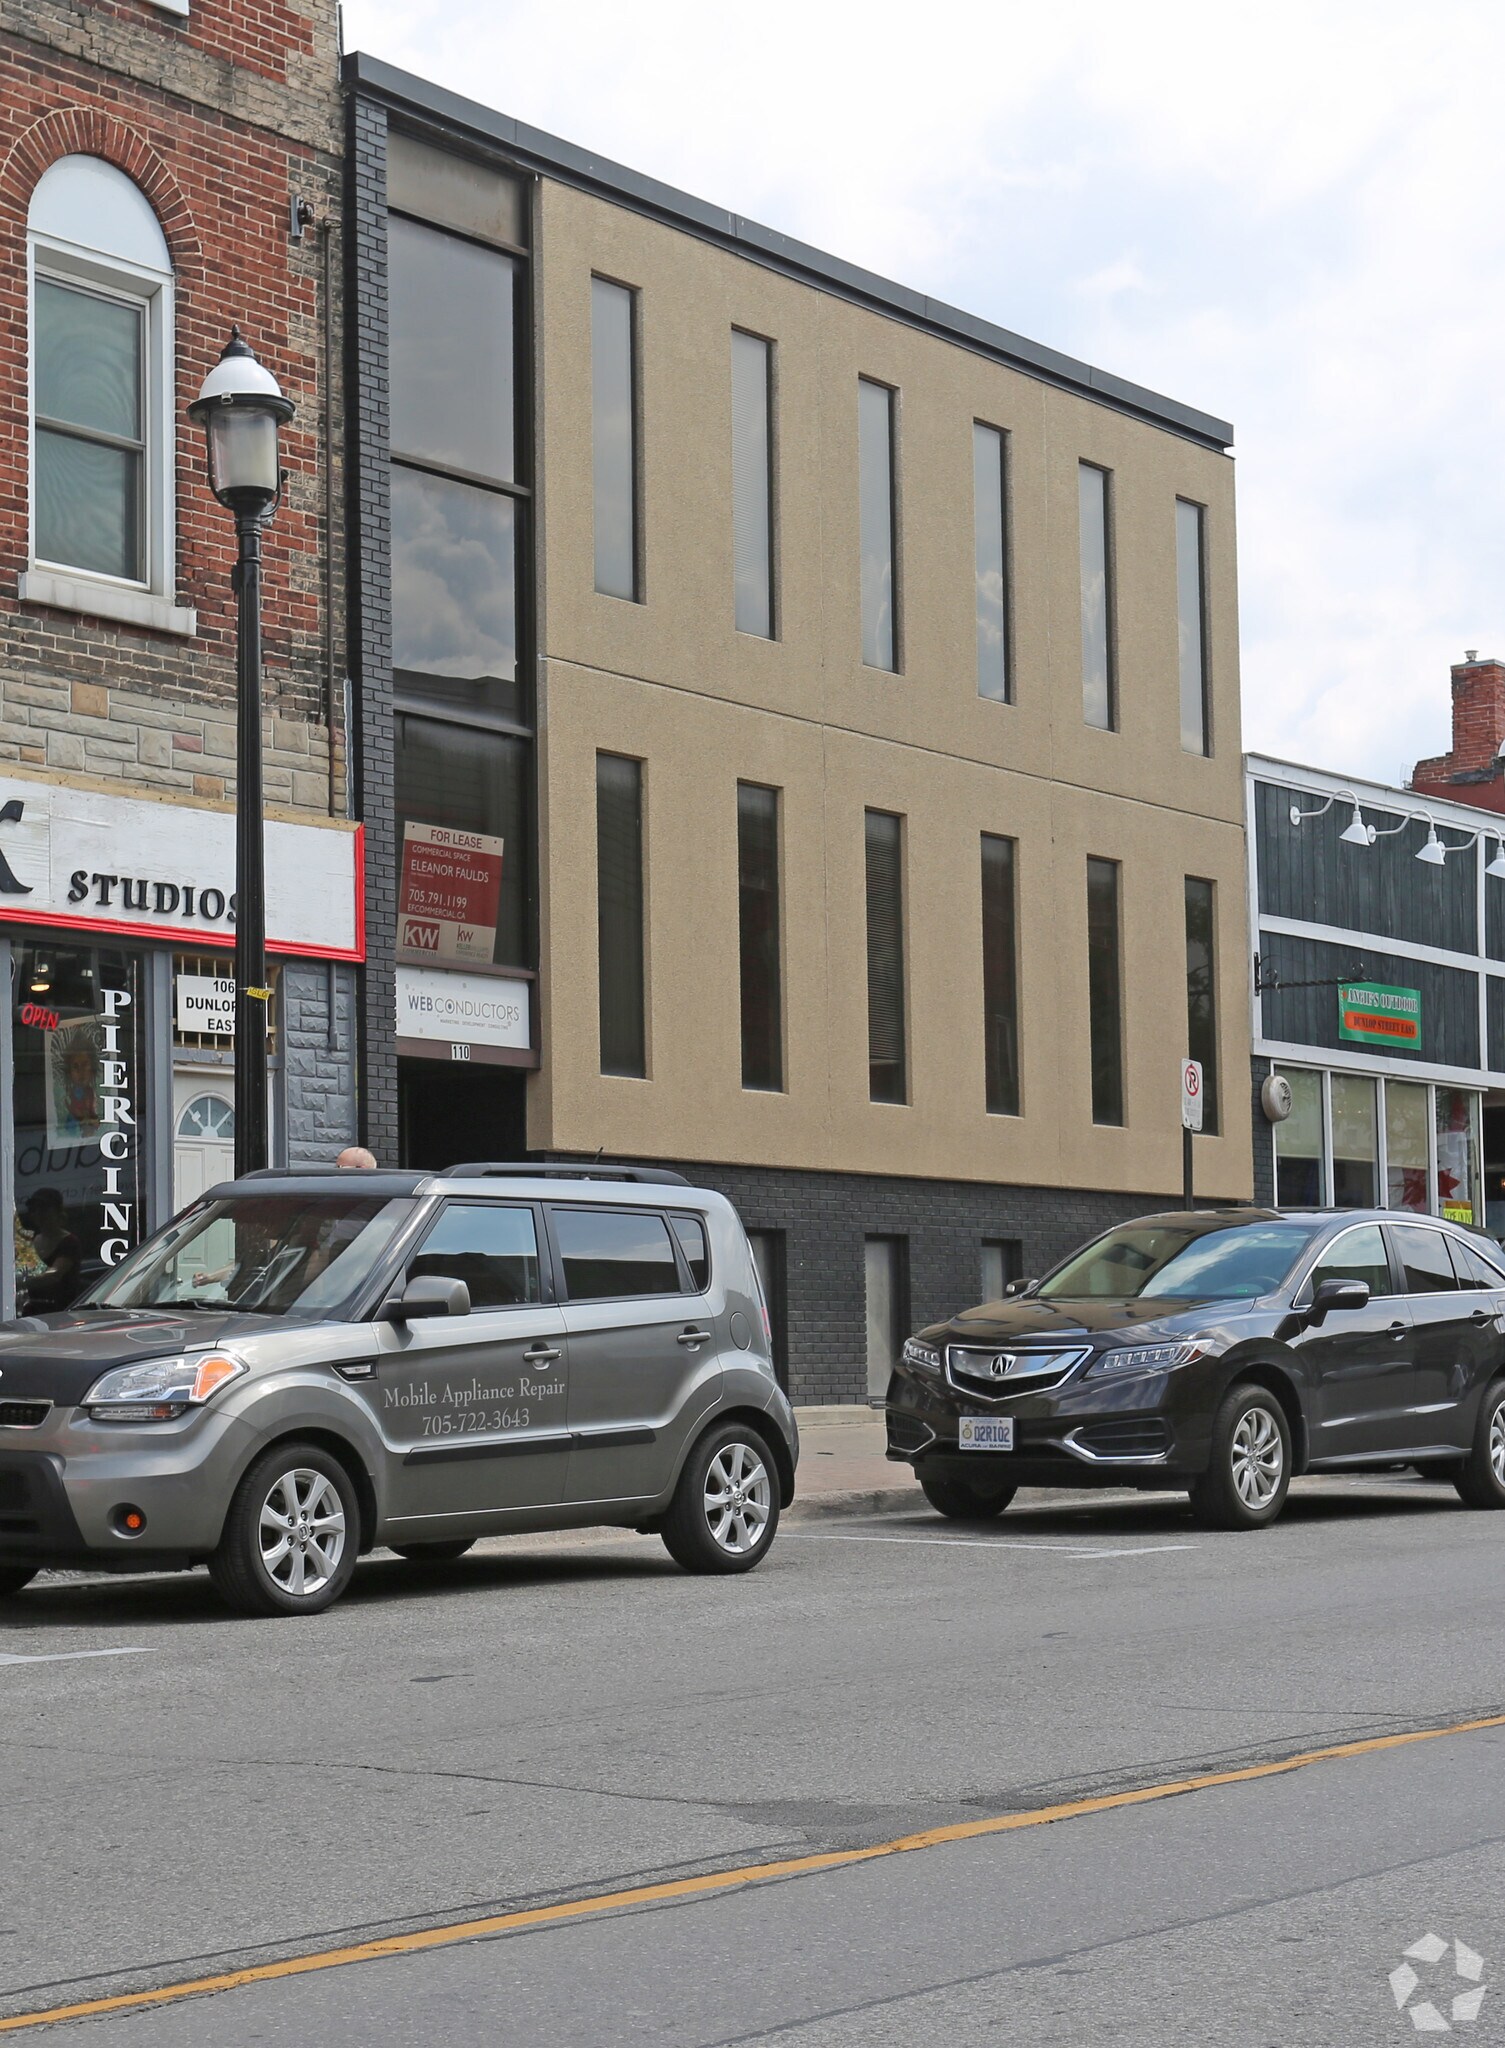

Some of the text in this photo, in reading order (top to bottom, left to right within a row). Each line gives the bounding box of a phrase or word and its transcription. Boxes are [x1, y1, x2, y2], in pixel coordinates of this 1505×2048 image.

[430, 829, 482, 849] FOR LEASE
[412, 844, 471, 862] COMMERCIAL SPACE
[411, 859, 489, 883] ELEANOR FAULDS
[409, 889, 467, 909] 705.791.1199
[407, 903, 466, 920] EFCOMMERCIAL.CA
[403, 924, 440, 948] KW
[213, 980, 235, 994] 106
[1347, 988, 1379, 1008] ANGIE'S
[1380, 993, 1419, 1013] OUTDOOR
[21, 1002, 60, 1032] OPEN
[1353, 1016, 1415, 1035] DUNLOP STREET EAST
[453, 1045, 470, 1059] 110
[100, 988, 136, 1267] PIERCING
[384, 1377, 565, 1408] Mobile Appliance Repair
[422, 1407, 530, 1436] 705-722-3643
